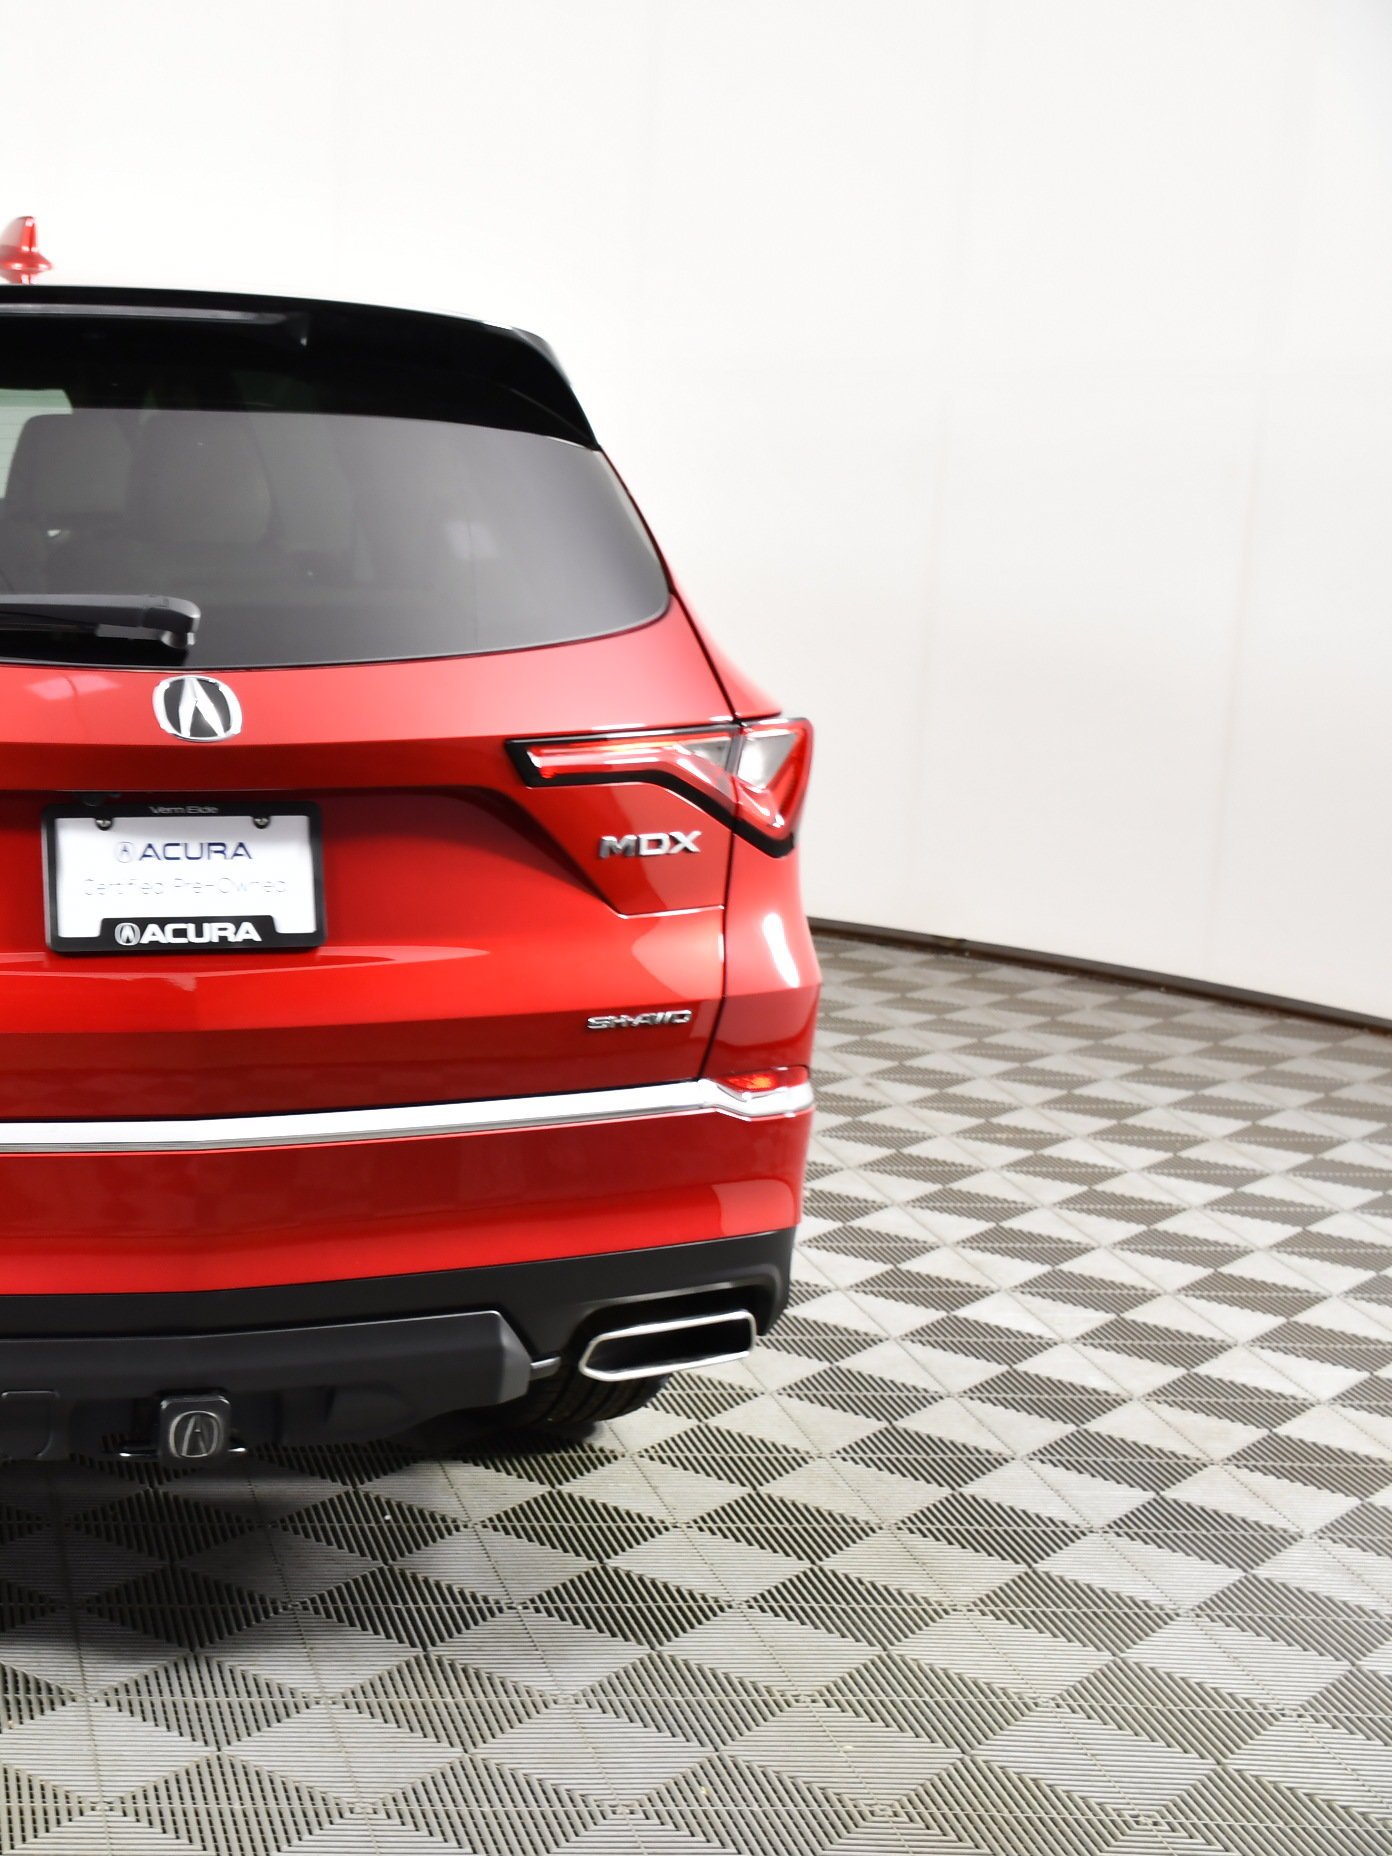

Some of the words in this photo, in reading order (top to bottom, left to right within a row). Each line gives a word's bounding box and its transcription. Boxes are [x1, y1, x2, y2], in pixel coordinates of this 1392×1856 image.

[139, 842, 253, 861] ACURA
[598, 830, 702, 858] MDX
[140, 922, 262, 944] ACURA
